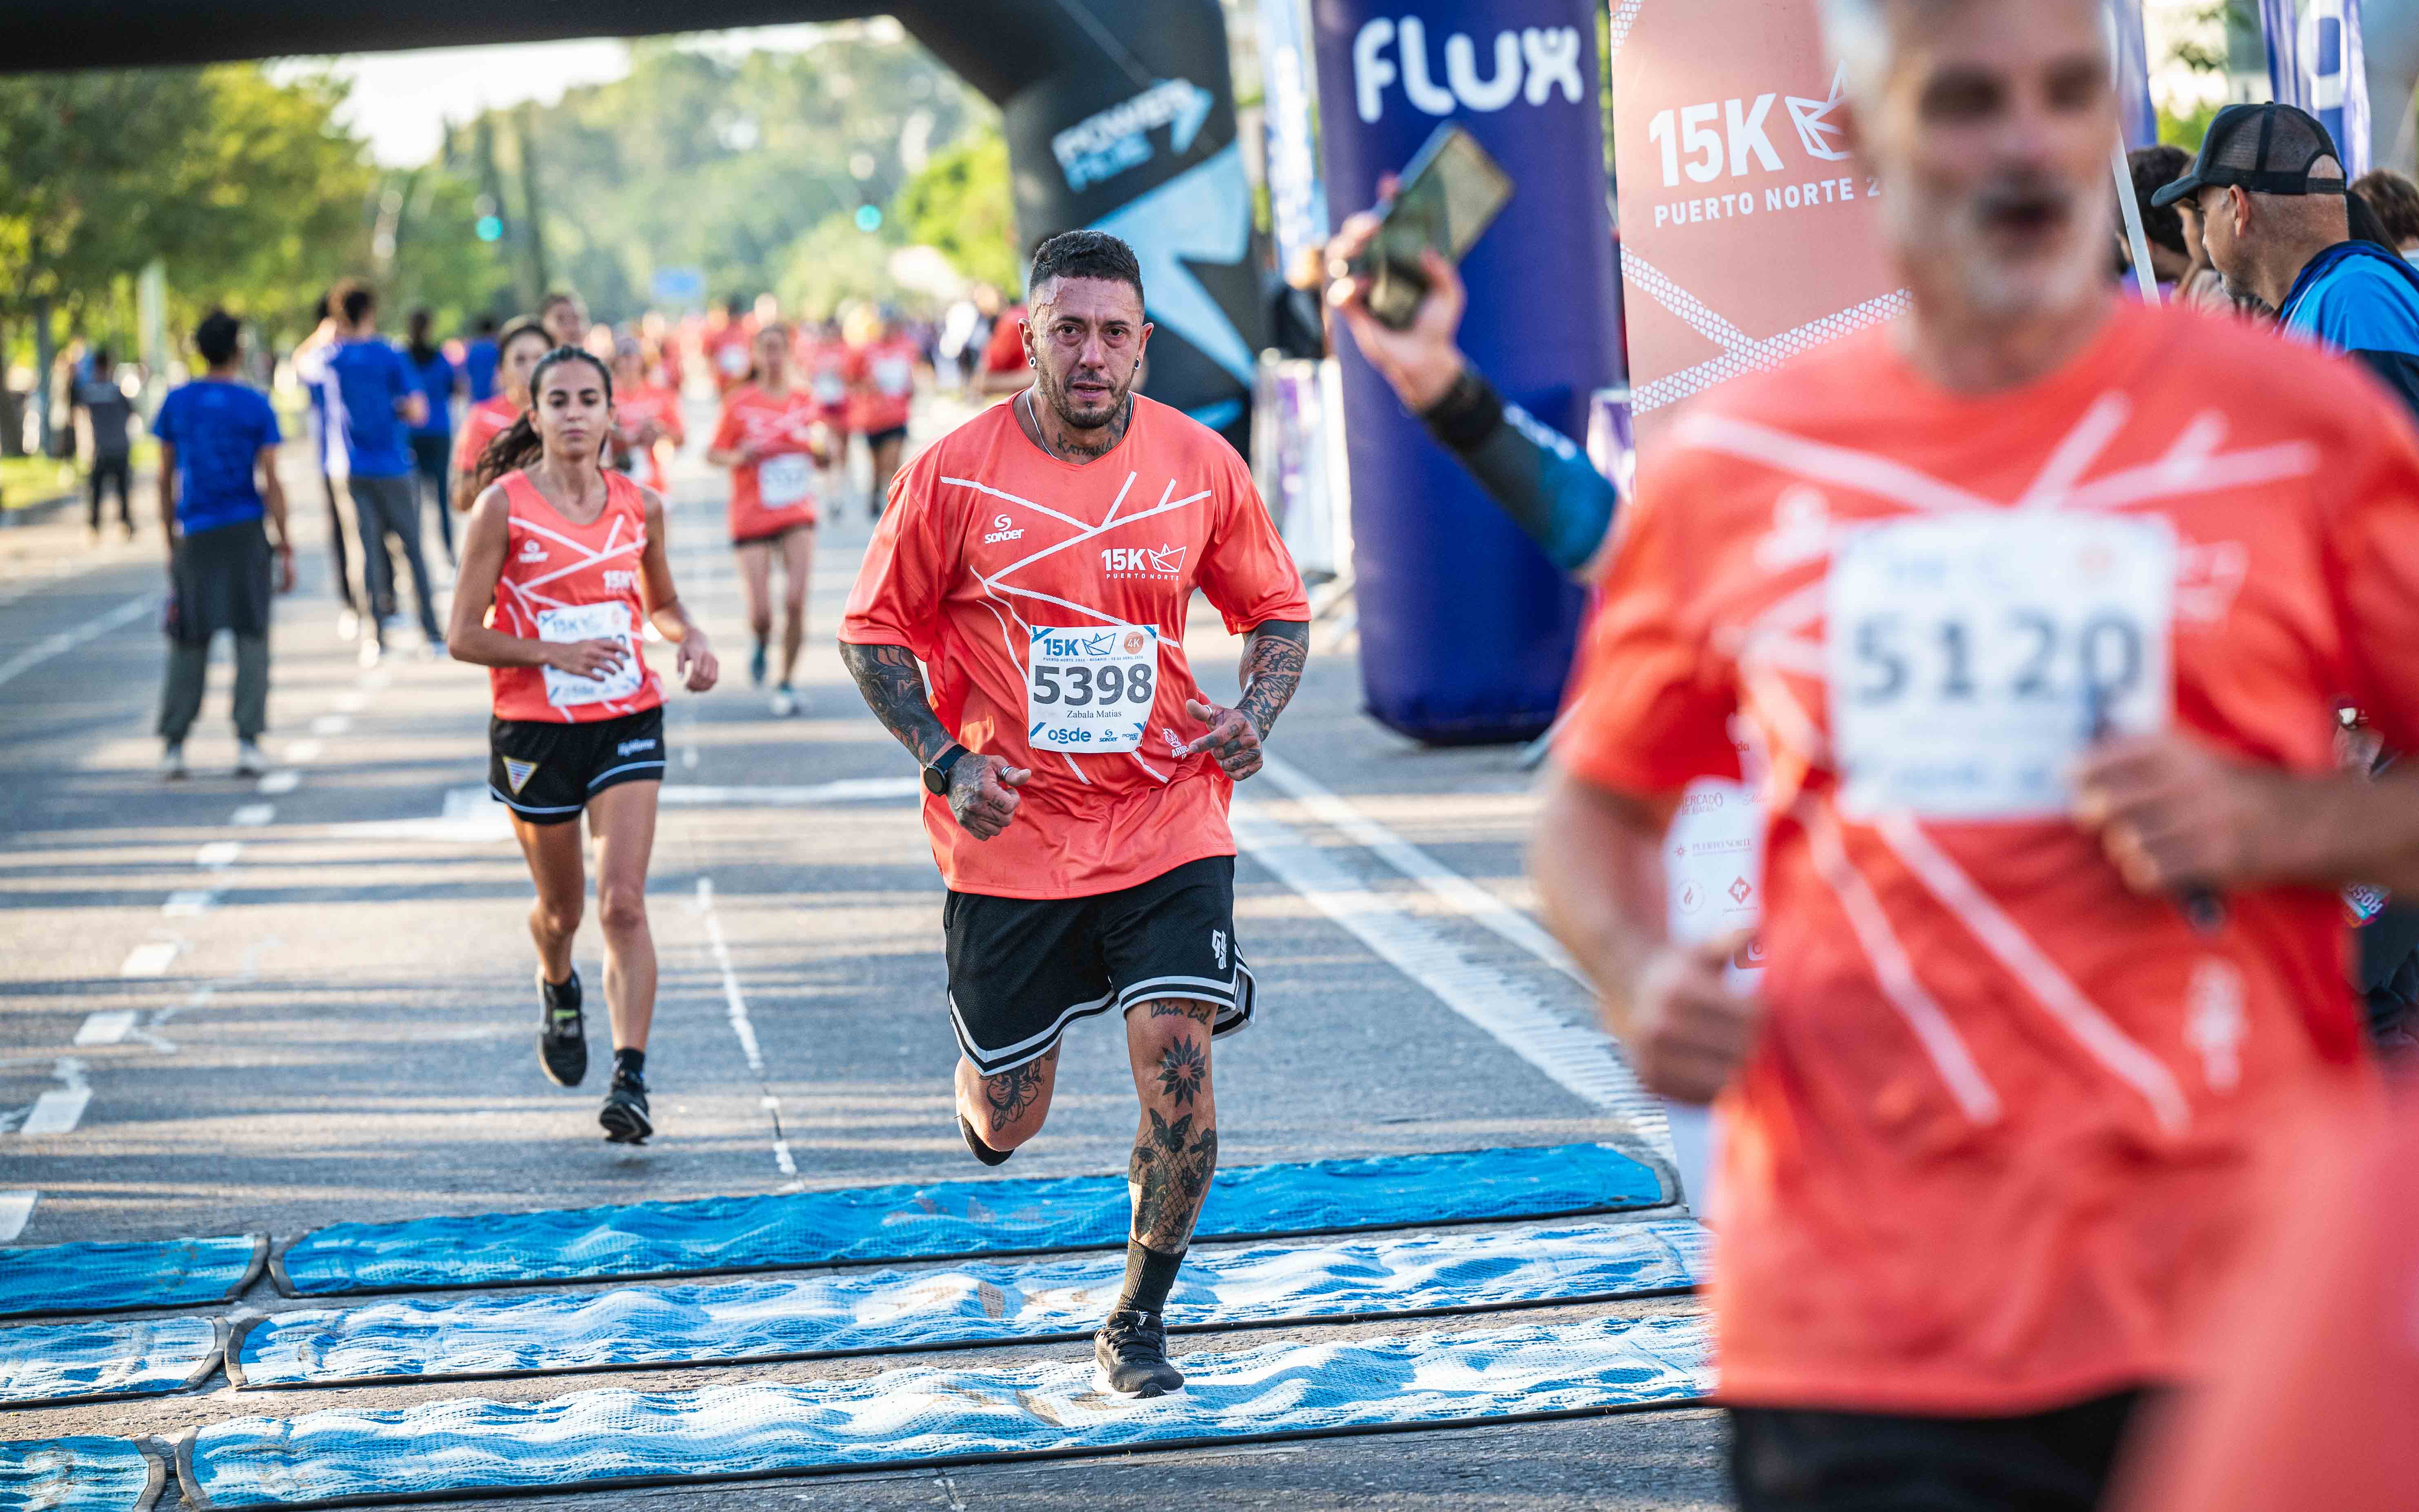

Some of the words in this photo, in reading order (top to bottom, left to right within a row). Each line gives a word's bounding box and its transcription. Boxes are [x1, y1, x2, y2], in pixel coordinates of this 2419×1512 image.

[1648, 93, 1784, 187] 15K
[1654, 192, 1754, 228] PUERTO
[1766, 178, 1854, 211] NORTE
[1101, 548, 1146, 571] 15K
[1044, 638, 1079, 656] 15K
[1127, 638, 1140, 648] 4K
[1853, 607, 2143, 705] 5120
[1033, 664, 1152, 706] 5398
[1067, 710, 1094, 718] Zabala
[1096, 710, 1122, 718] Matias
[1048, 727, 1091, 744] osde
